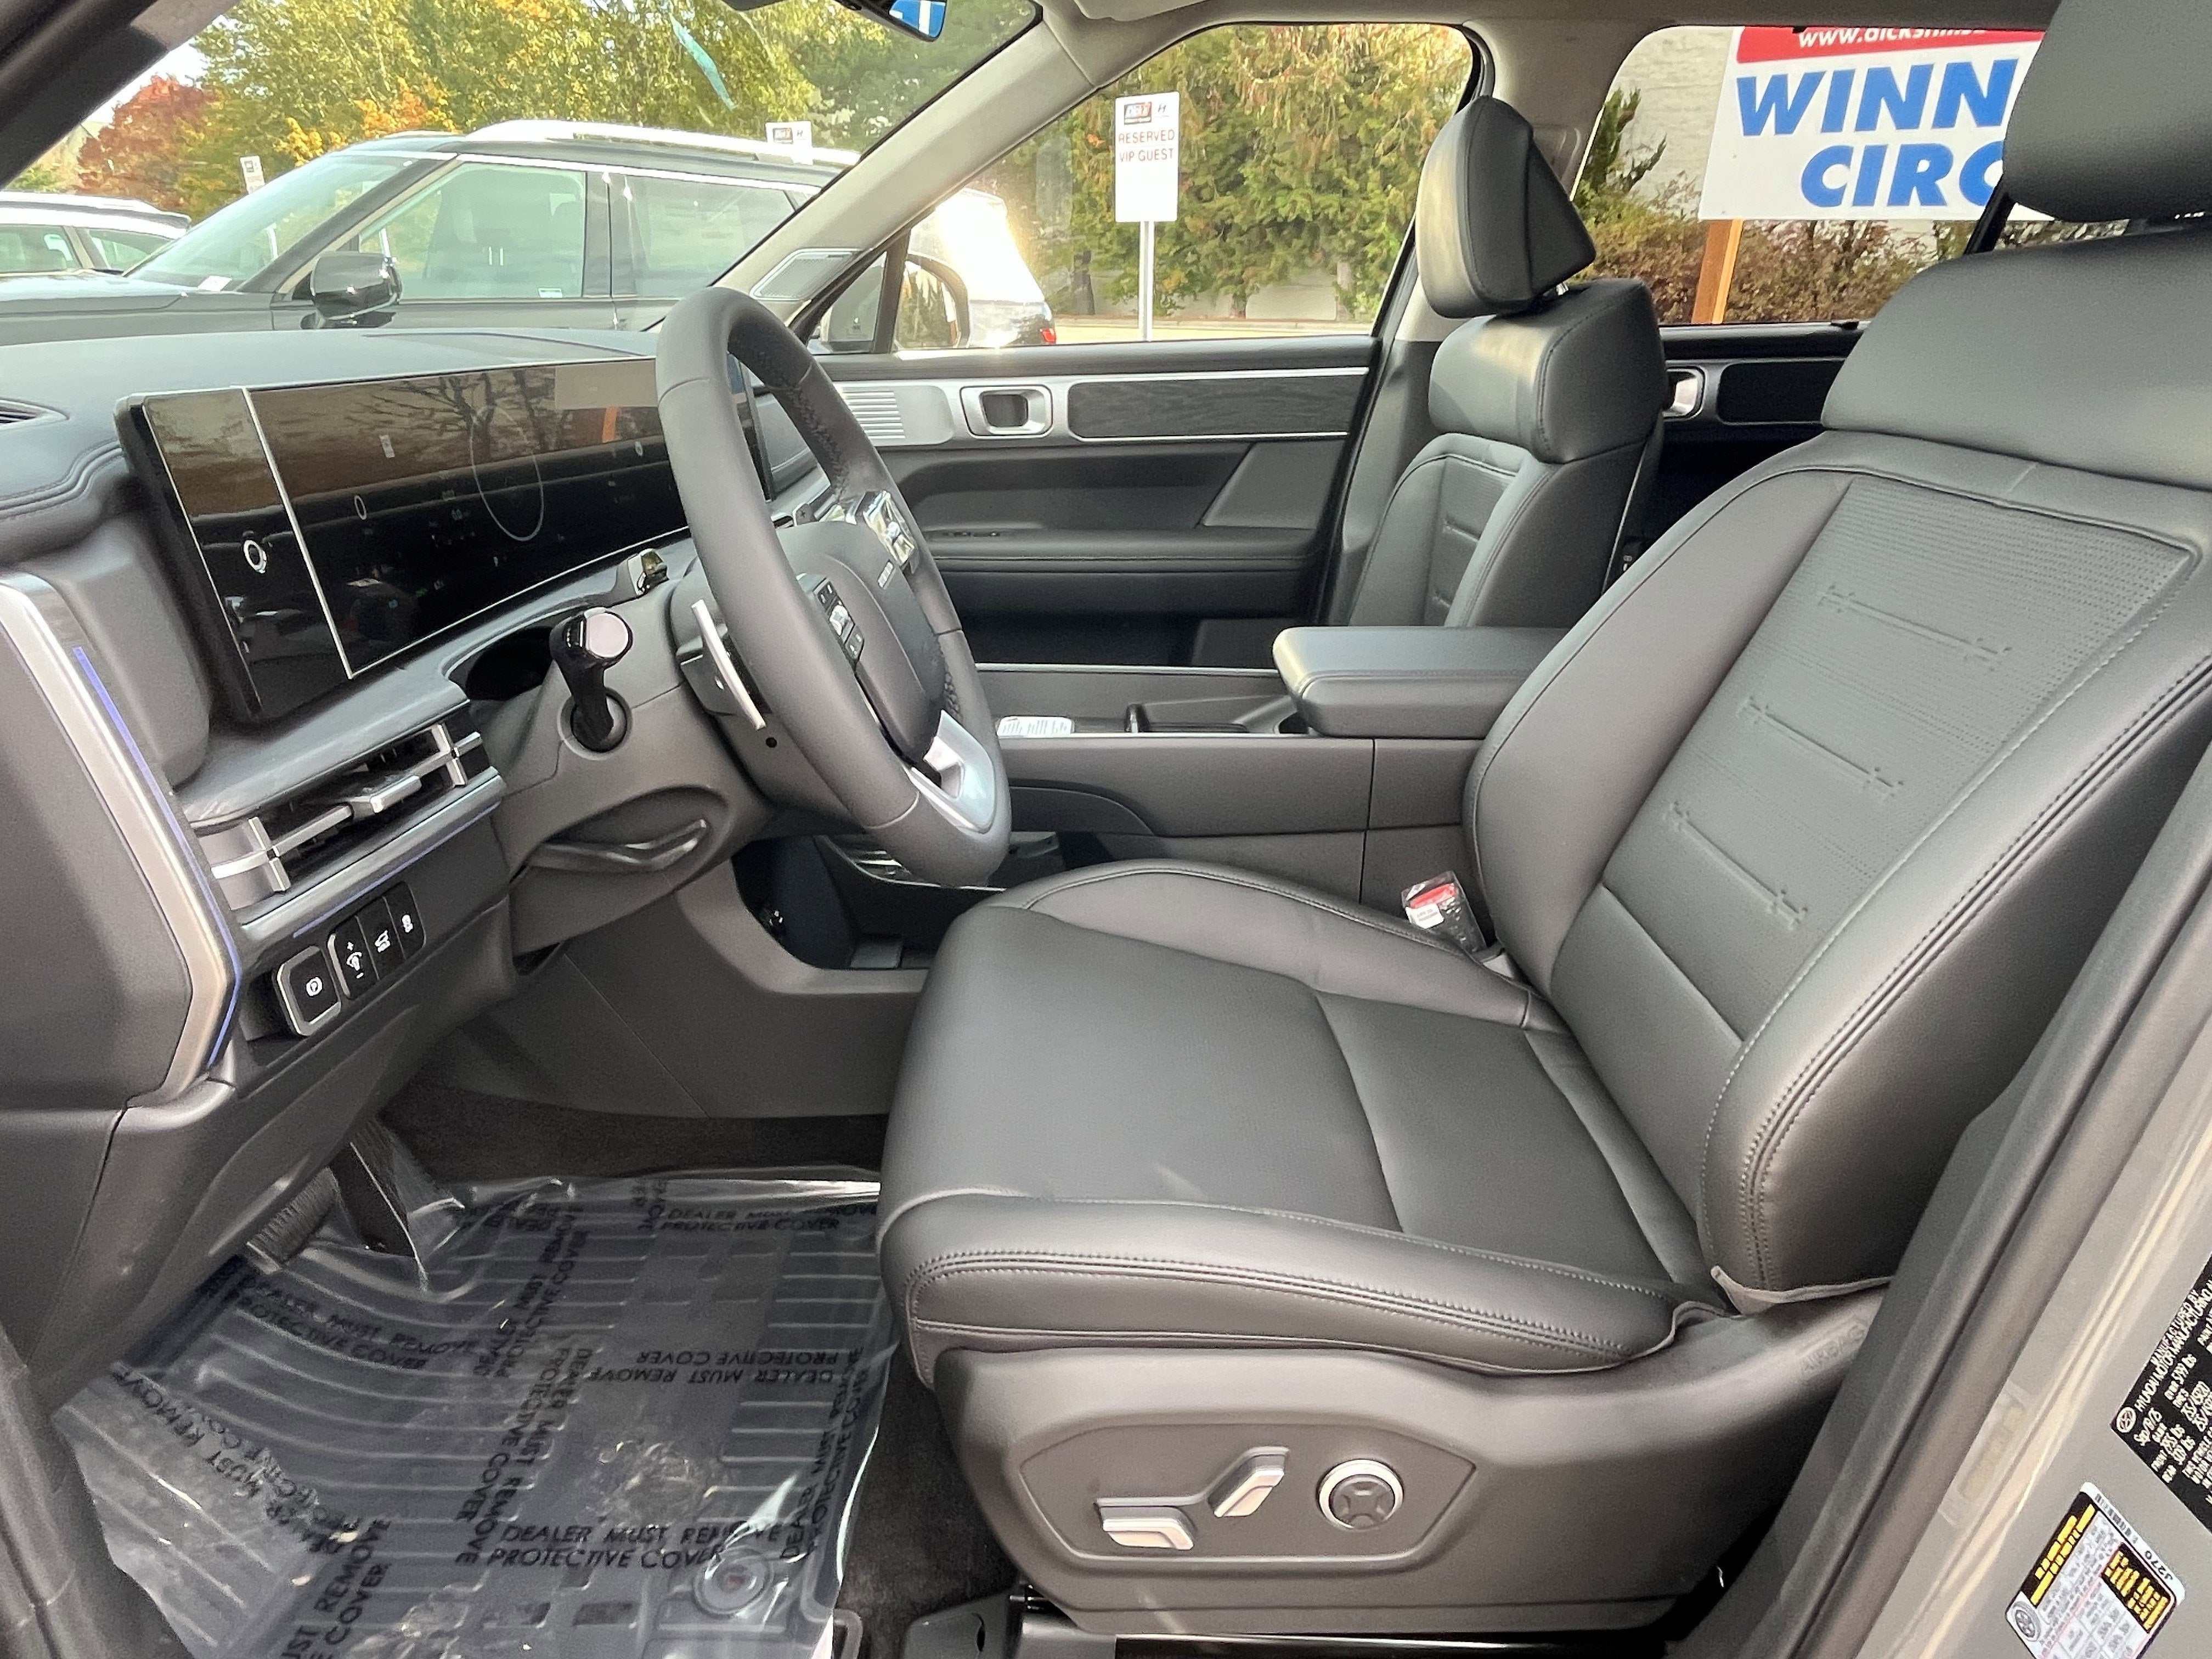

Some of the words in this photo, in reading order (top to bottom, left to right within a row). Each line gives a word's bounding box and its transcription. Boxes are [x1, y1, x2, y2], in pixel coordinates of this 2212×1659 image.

[1736, 58, 2019, 137] WINN
[1119, 129, 1175, 144] RESERVED
[1120, 150, 1135, 162] VIP
[1138, 148, 1174, 161] GUEST
[774, 1218, 839, 1231] COVER
[635, 1350, 711, 1365] COVER
[715, 1352, 839, 1365] PROTECTIVE
[585, 1368, 678, 1384] REMOVE
[687, 1369, 744, 1384] MUST
[456, 1452, 510, 1521] COVER
[455, 1477, 523, 1565] REMOVE
[503, 1525, 593, 1544] DEALER
[604, 1525, 668, 1544] MUST
[487, 1548, 636, 1568] PROTECTIVE
[641, 1543, 724, 1569] COVER
[2145, 1550, 2174, 1581] J270
[313, 1520, 391, 1613] REMOVE
[324, 1563, 393, 1645] COVER
